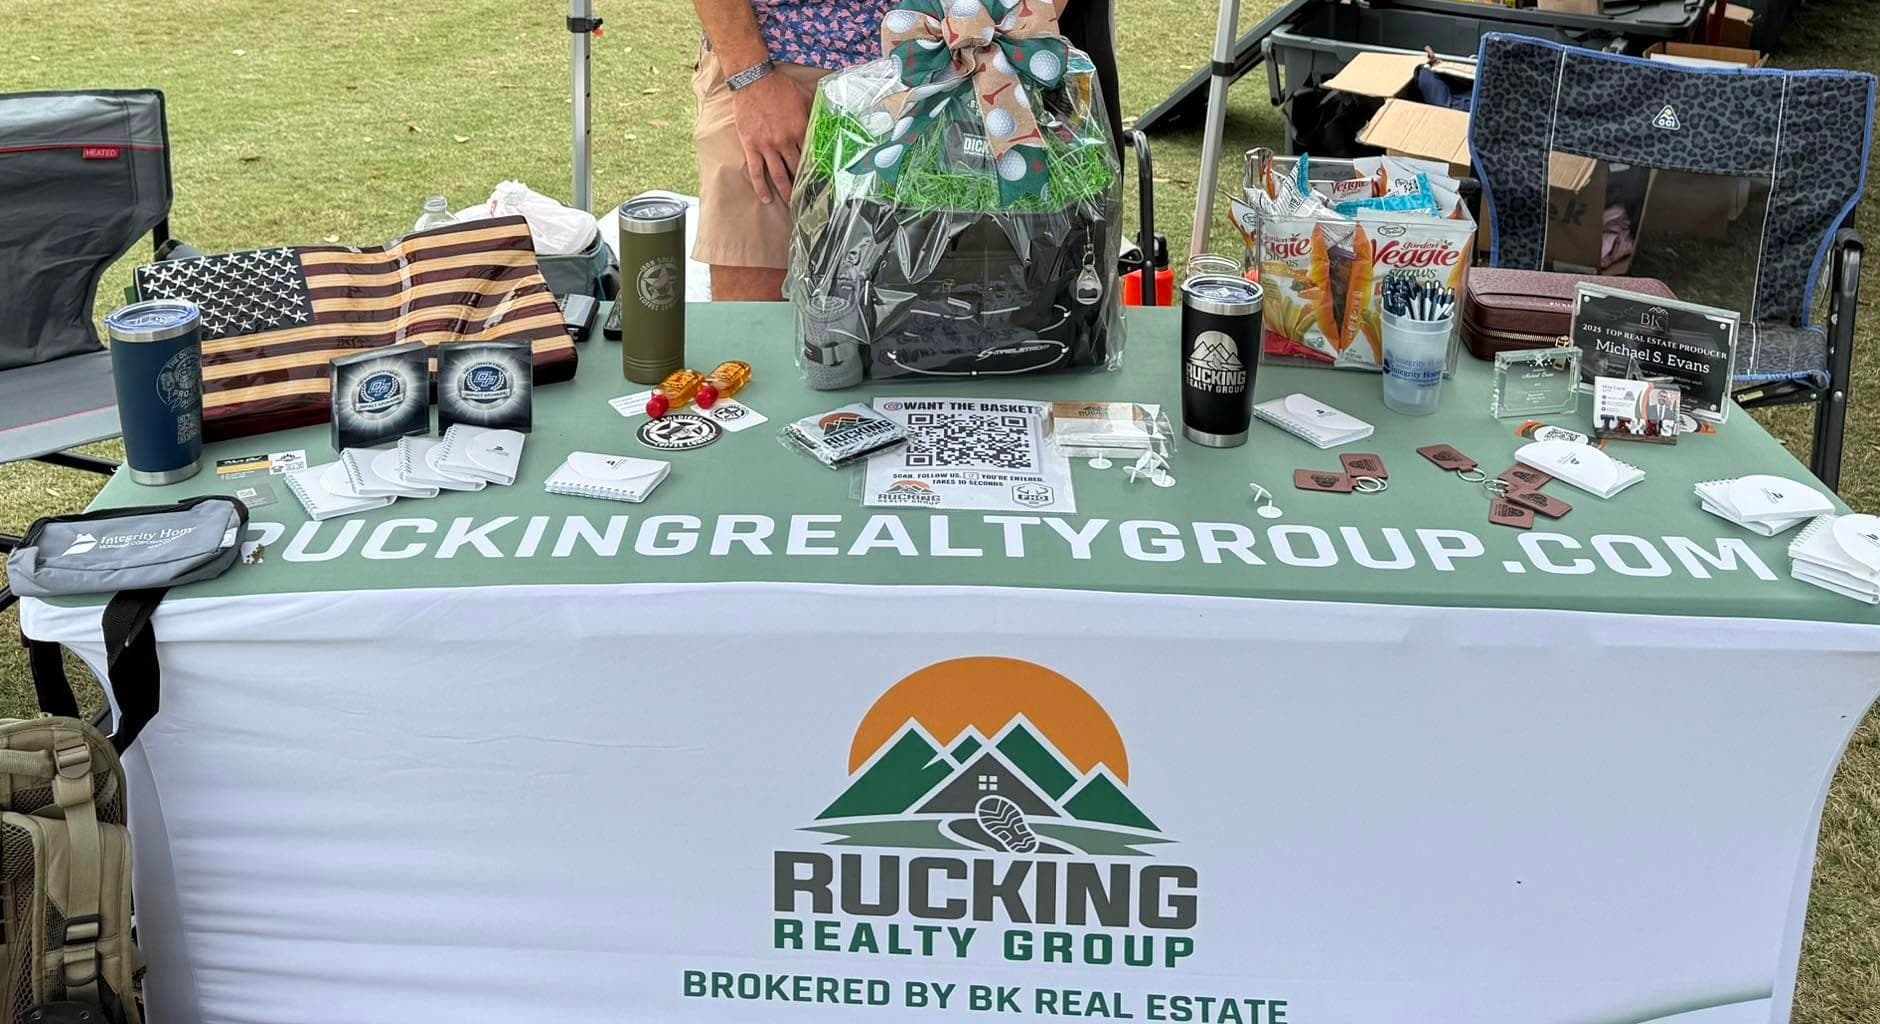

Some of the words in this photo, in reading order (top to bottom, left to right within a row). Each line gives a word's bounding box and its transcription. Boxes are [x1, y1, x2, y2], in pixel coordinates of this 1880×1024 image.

[85, 148, 117, 157] HEATED
[963, 136, 989, 154] DICK
[1371, 239, 1460, 269] Veggie
[1400, 240, 1440, 251] garden
[1640, 312, 1662, 330] BK
[1606, 328, 1623, 337] TOP
[1624, 332, 1646, 343] REAL
[1647, 338, 1678, 350] ESTATE
[1679, 343, 1728, 360] PRODUCER
[1595, 338, 1650, 362] Michael
[1652, 351, 1665, 365] S.
[1667, 355, 1711, 374] Evans
[1186, 361, 1247, 386] RUCKING
[1215, 384, 1246, 394] GROUP
[903, 401, 945, 411] WANT
[948, 401, 974, 411] THE
[822, 418, 893, 447] RUCKING
[877, 493, 941, 502] RUCKING
[100, 531, 155, 546] Integrity
[773, 850, 1199, 931] RUCKING
[773, 918, 977, 960] REALTY
[1002, 929, 1195, 970] GROUP
[682, 970, 891, 1007] BROKERED
[904, 982, 957, 1010] BY
[967, 985, 1023, 1014] BK
[1034, 989, 1134, 1020] REAL
[1146, 993, 1289, 1024] ESTATE
